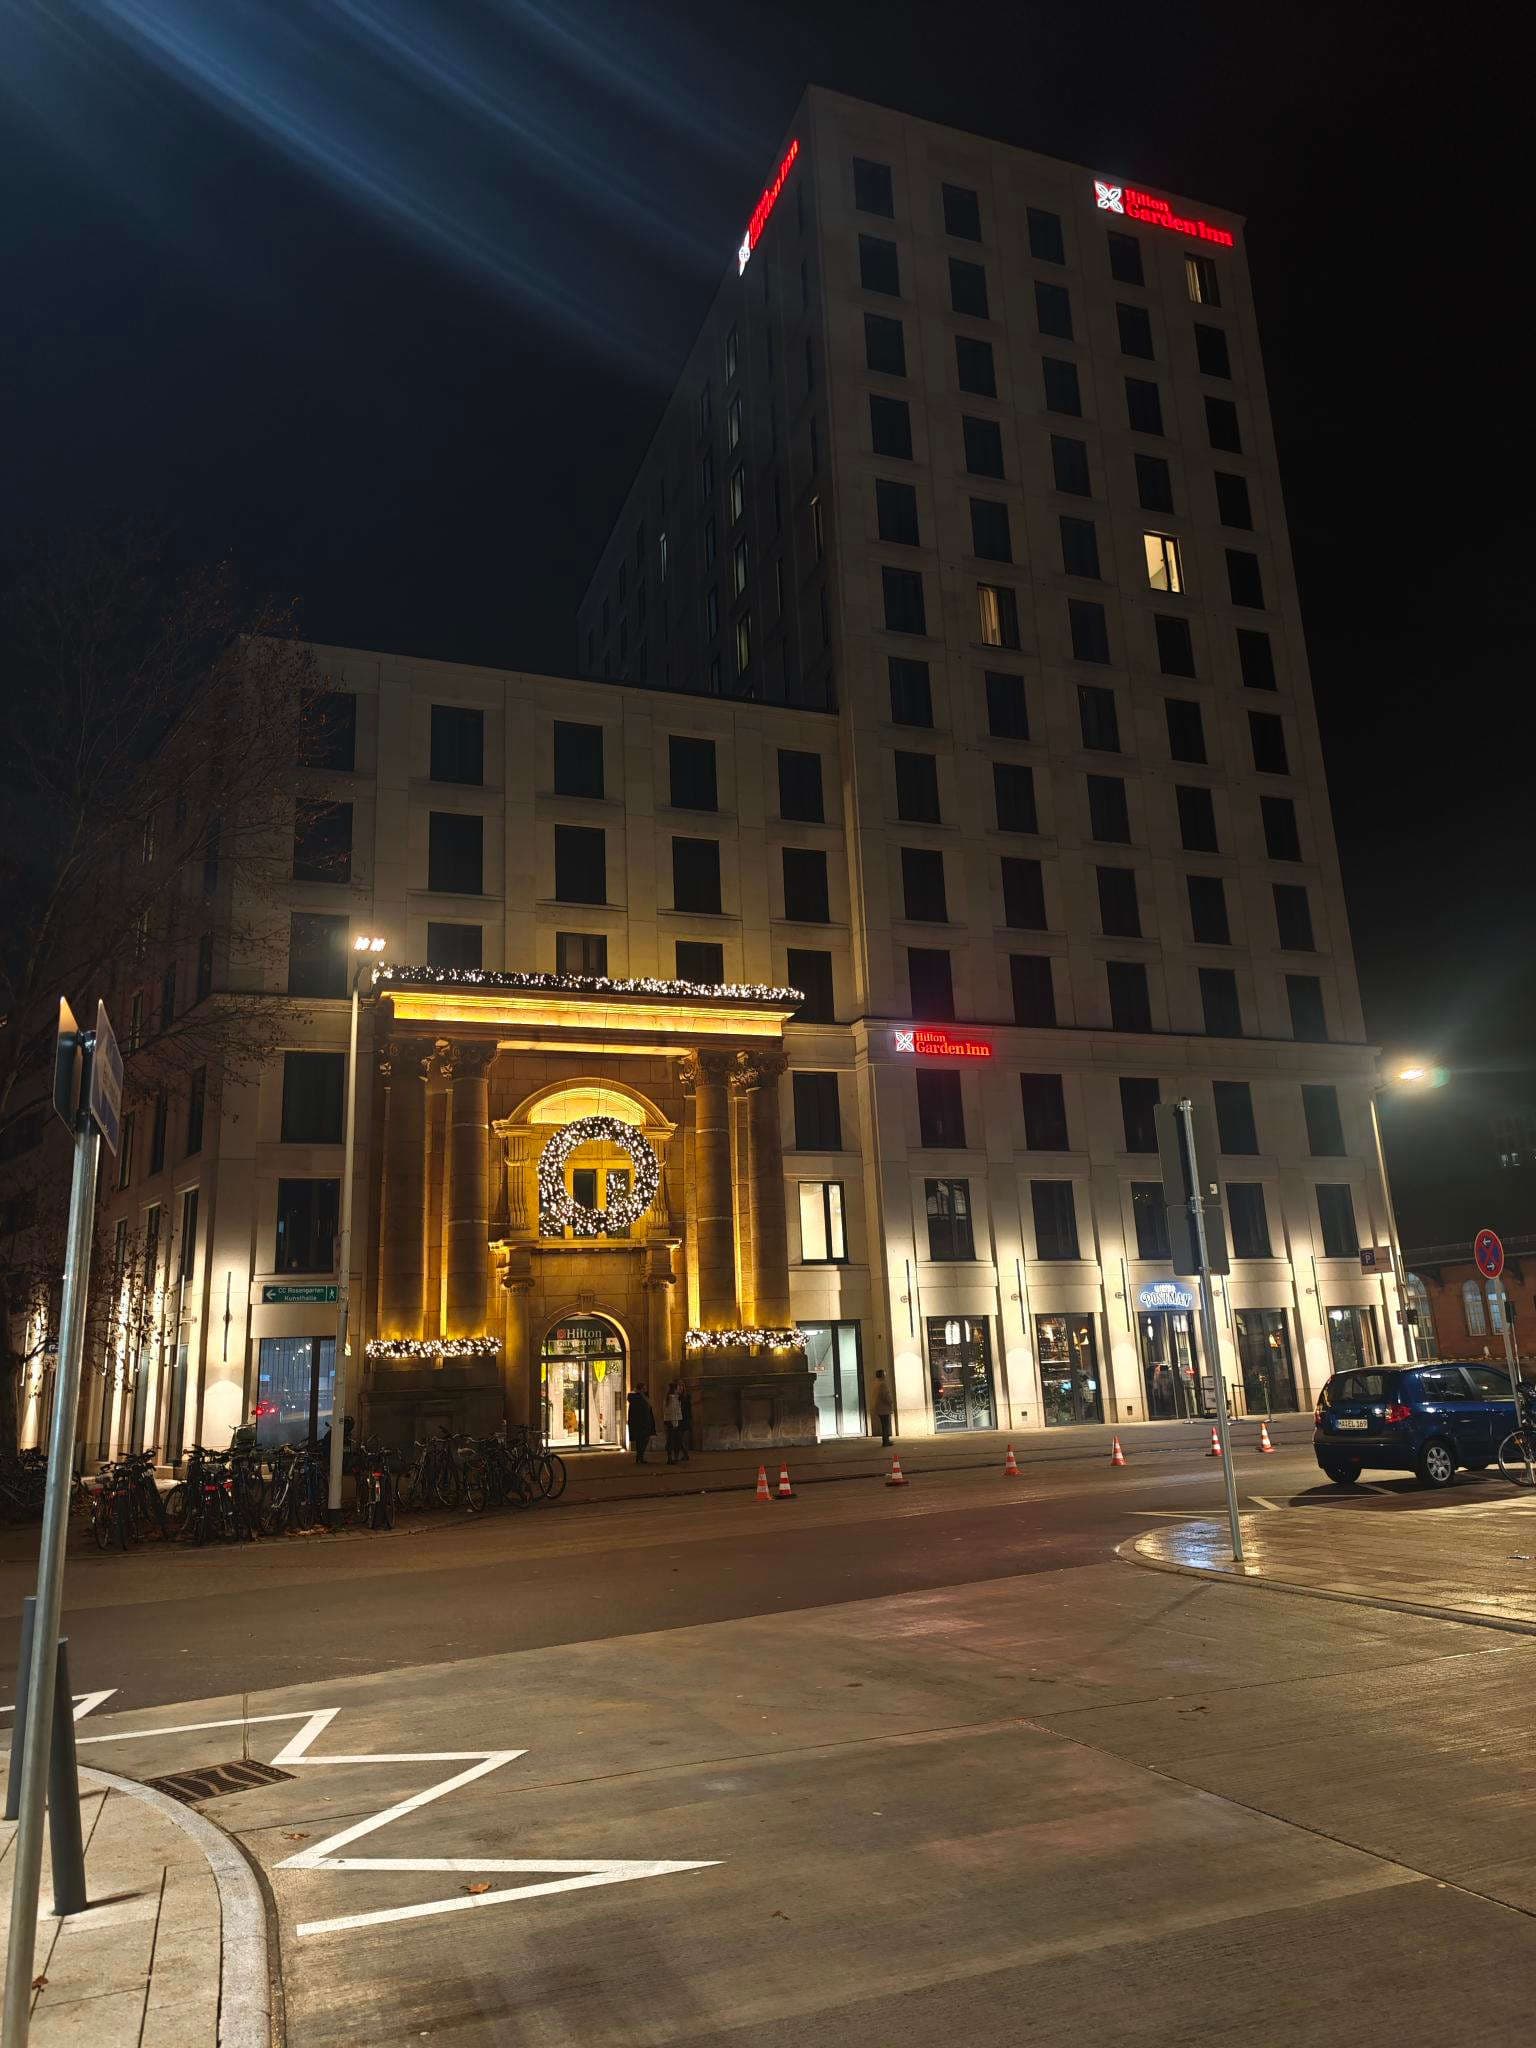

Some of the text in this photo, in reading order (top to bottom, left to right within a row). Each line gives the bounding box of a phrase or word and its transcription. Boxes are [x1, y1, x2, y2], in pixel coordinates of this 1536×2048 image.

[1125, 189, 1170, 212] Hilton
[1125, 202, 1234, 247] Garden Inn
[916, 1032, 946, 1042] Hilton
[916, 1042, 990, 1056] Garden Inn
[288, 1287, 324, 1295] Rosengarten
[567, 1328, 602, 1339] Hilton
